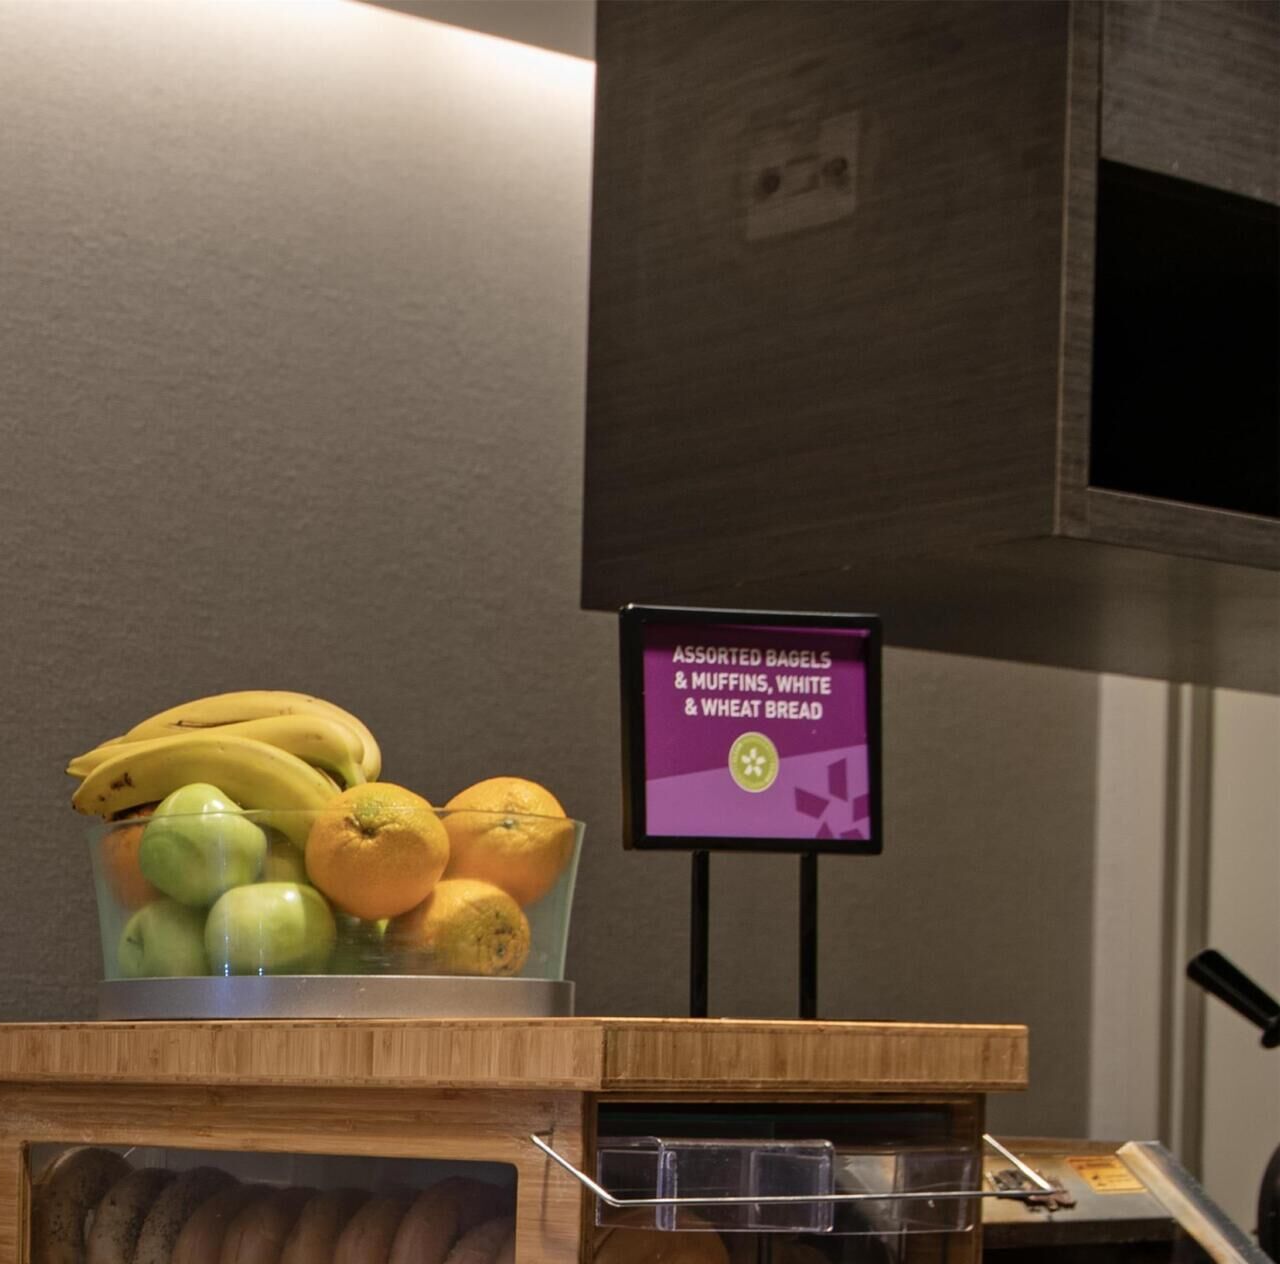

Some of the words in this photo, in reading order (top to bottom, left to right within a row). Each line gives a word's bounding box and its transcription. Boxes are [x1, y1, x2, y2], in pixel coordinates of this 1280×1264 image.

[672, 645, 762, 666] ASSORTED
[765, 648, 832, 669] BAGELS
[674, 671, 687, 690] &
[692, 671, 773, 695] MUFFINS,
[775, 675, 832, 695] WHITE
[685, 697, 698, 716] &
[701, 698, 762, 718] WHEAT
[765, 700, 823, 720] BREAD
